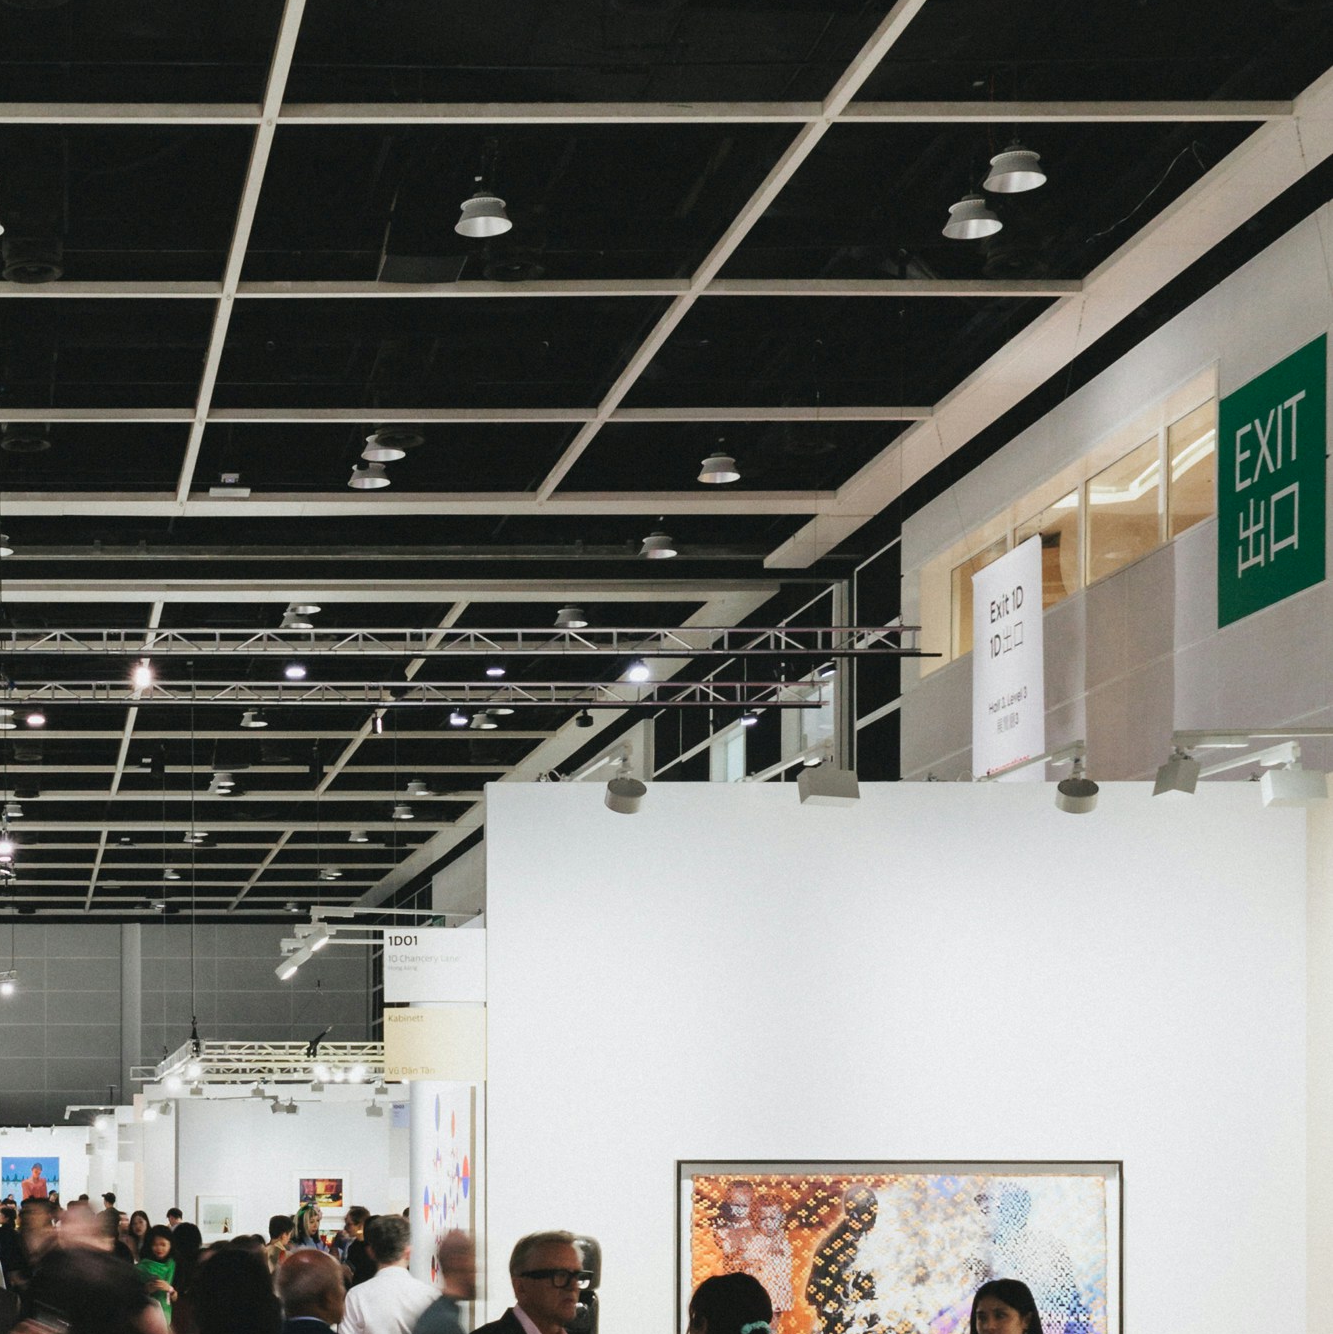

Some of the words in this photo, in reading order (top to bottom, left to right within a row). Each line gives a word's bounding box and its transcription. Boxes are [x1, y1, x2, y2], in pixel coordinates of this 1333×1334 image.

[1235, 389, 1306, 493] EXIT
[1237, 481, 1300, 579] 出口
[990, 593, 1010, 624] Exit
[1011, 585, 1024, 612] 1D
[988, 698, 1001, 715] Hall
[1007, 687, 1023, 707] Level
[388, 935, 418, 946] 1D01
[388, 954, 398, 963] 10
[399, 954, 439, 965] Chancery
[440, 954, 460, 963] Lane
[388, 1014, 424, 1023] Kabinett
